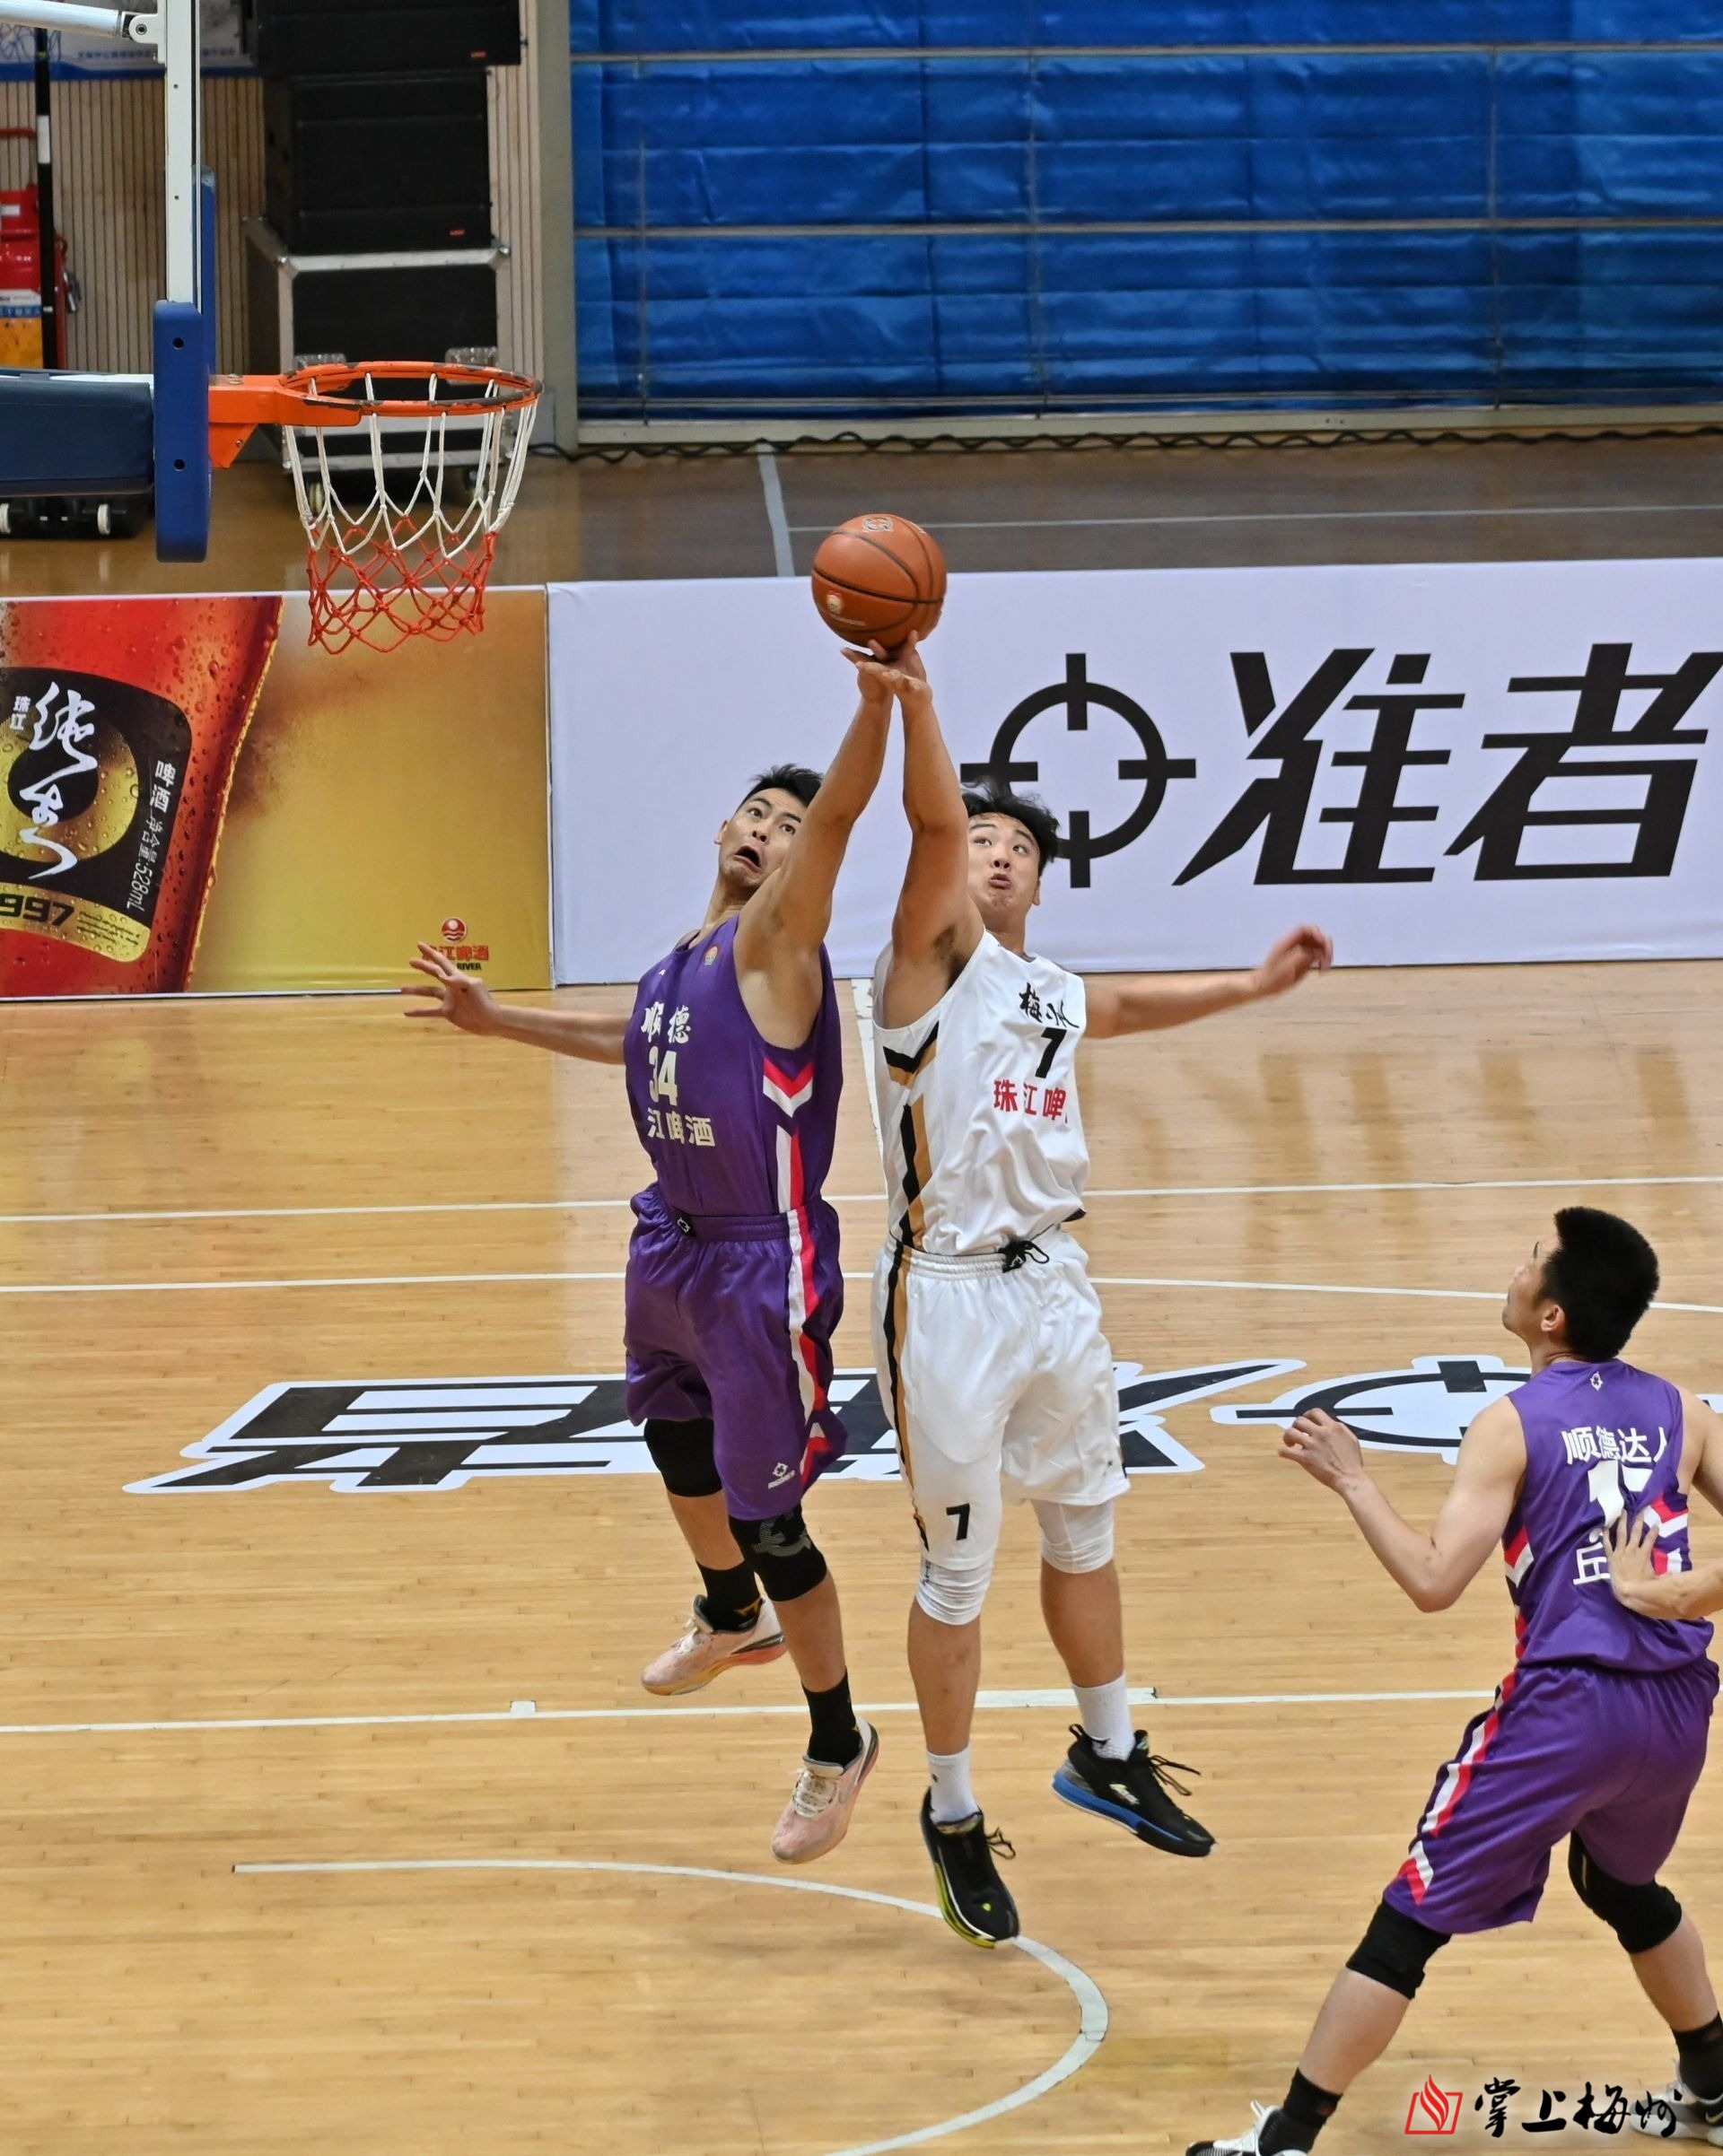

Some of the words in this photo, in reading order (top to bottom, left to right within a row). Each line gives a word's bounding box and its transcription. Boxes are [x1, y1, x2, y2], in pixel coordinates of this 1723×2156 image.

[149, 760, 177, 814] 啤酒
[1172, 642, 1723, 886] 准者
[423, 945, 489, 962] 江啤酒
[649, 1046, 678, 1106] 34
[1036, 1026, 1067, 1078] 7
[993, 1079, 1068, 1124] 珠江啤
[946, 1503, 970, 1541] 7
